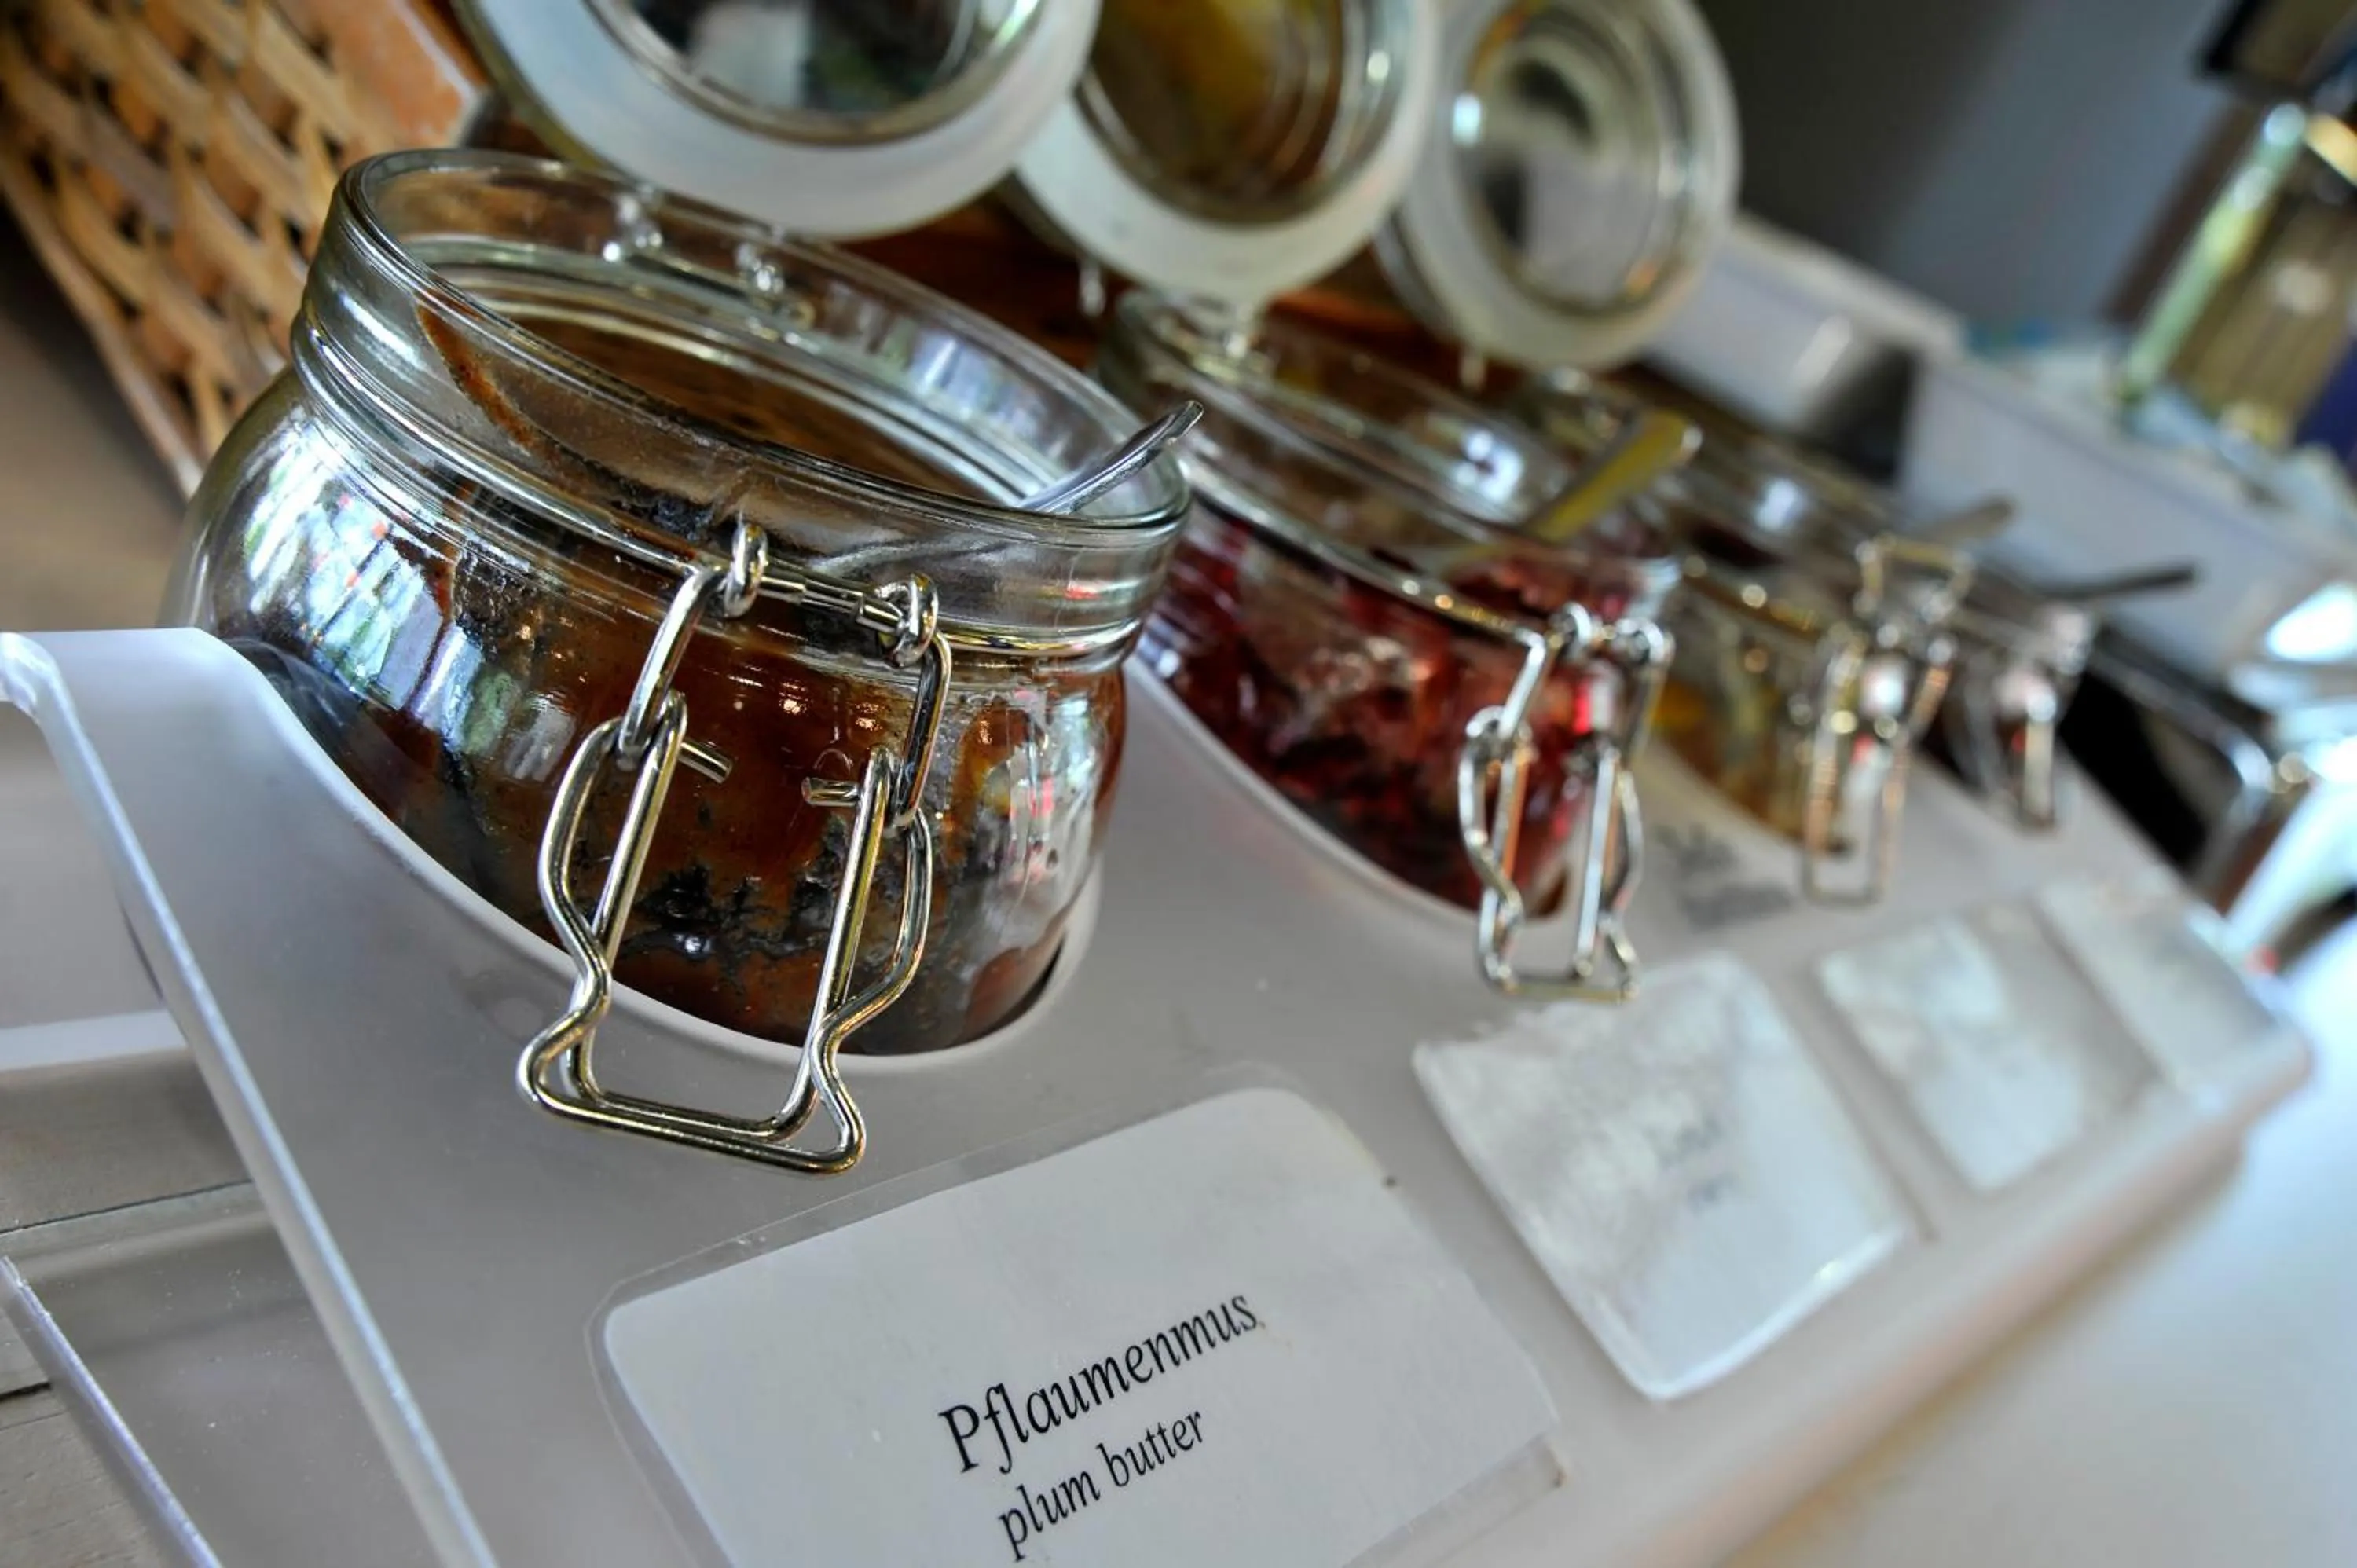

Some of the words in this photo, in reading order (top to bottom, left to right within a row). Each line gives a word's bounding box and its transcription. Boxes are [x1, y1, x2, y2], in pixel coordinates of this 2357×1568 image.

[937, 1295, 1259, 1475] Pflaumenmus
[997, 1471, 1101, 1563] plum
[1095, 1410, 1204, 1487] butter
